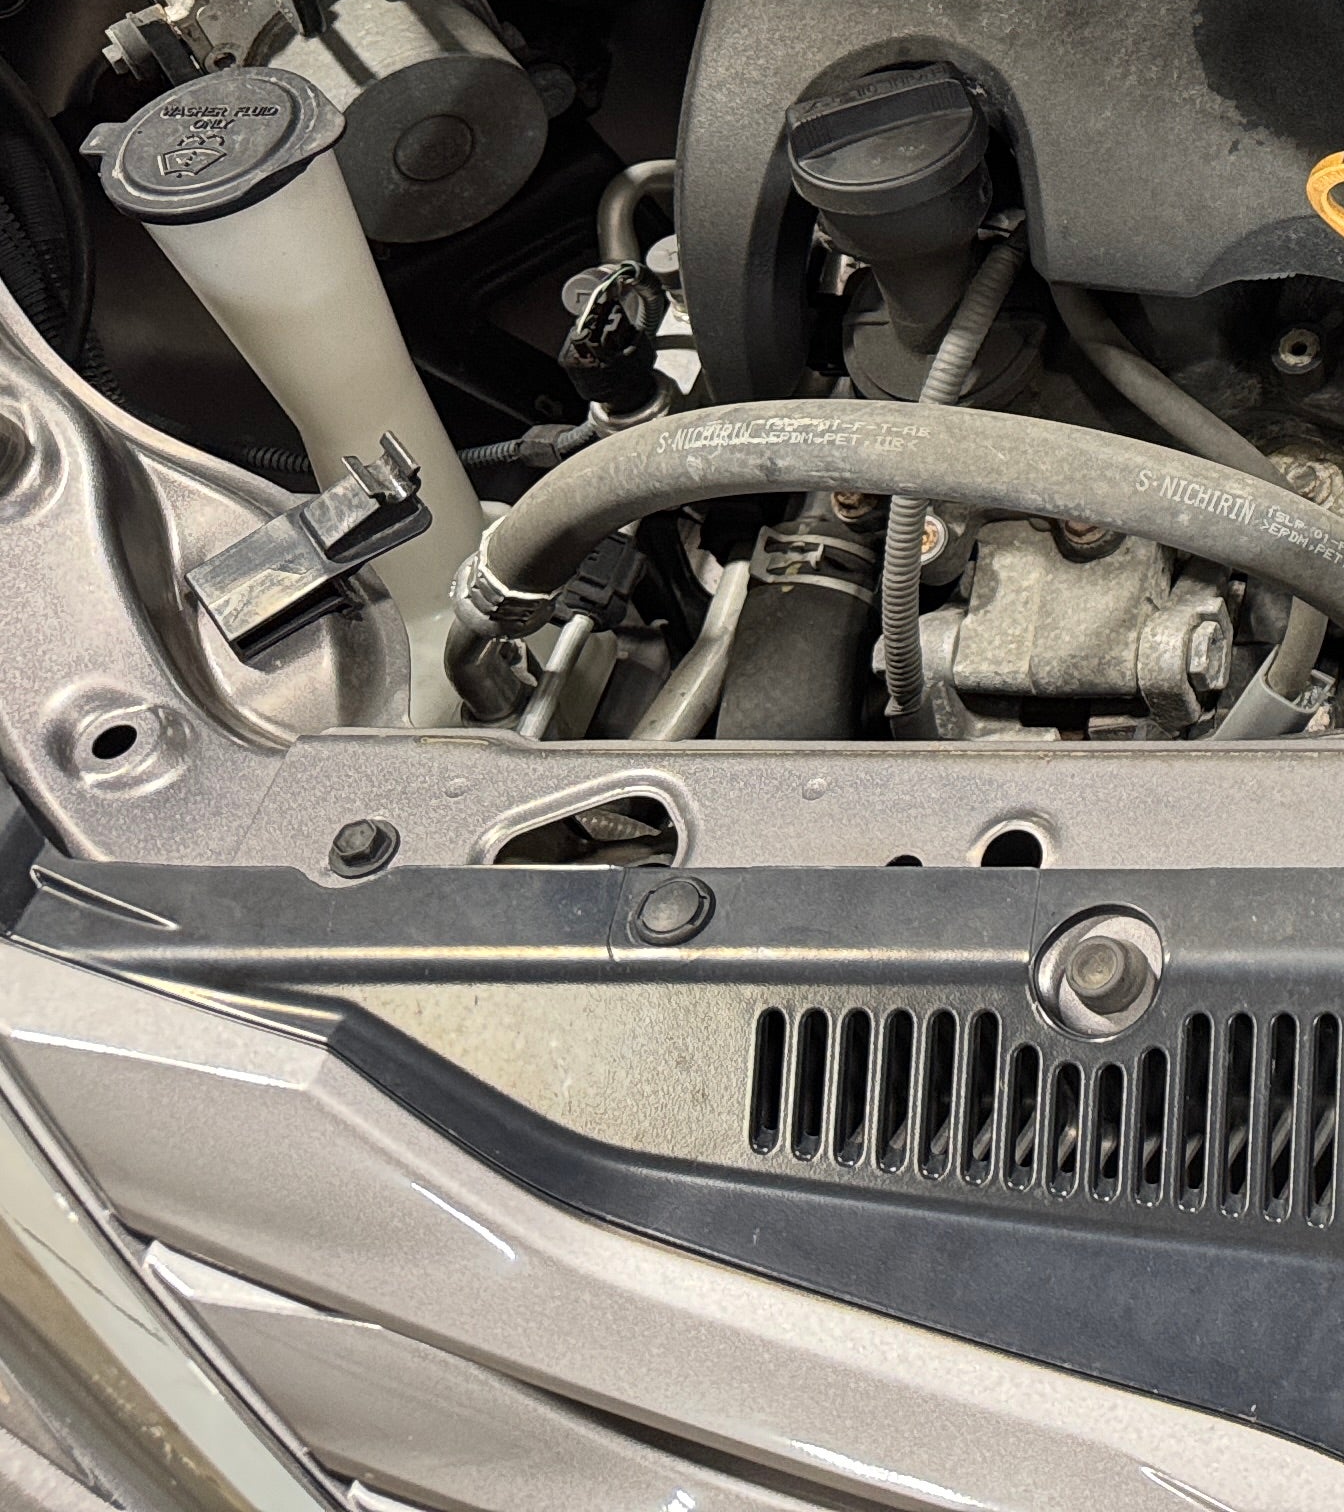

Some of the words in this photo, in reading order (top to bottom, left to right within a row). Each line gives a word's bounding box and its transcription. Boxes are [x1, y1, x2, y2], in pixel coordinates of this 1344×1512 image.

[160, 104, 229, 120] WASHER
[234, 103, 281, 119] FLUID
[190, 117, 236, 132] ONLY
